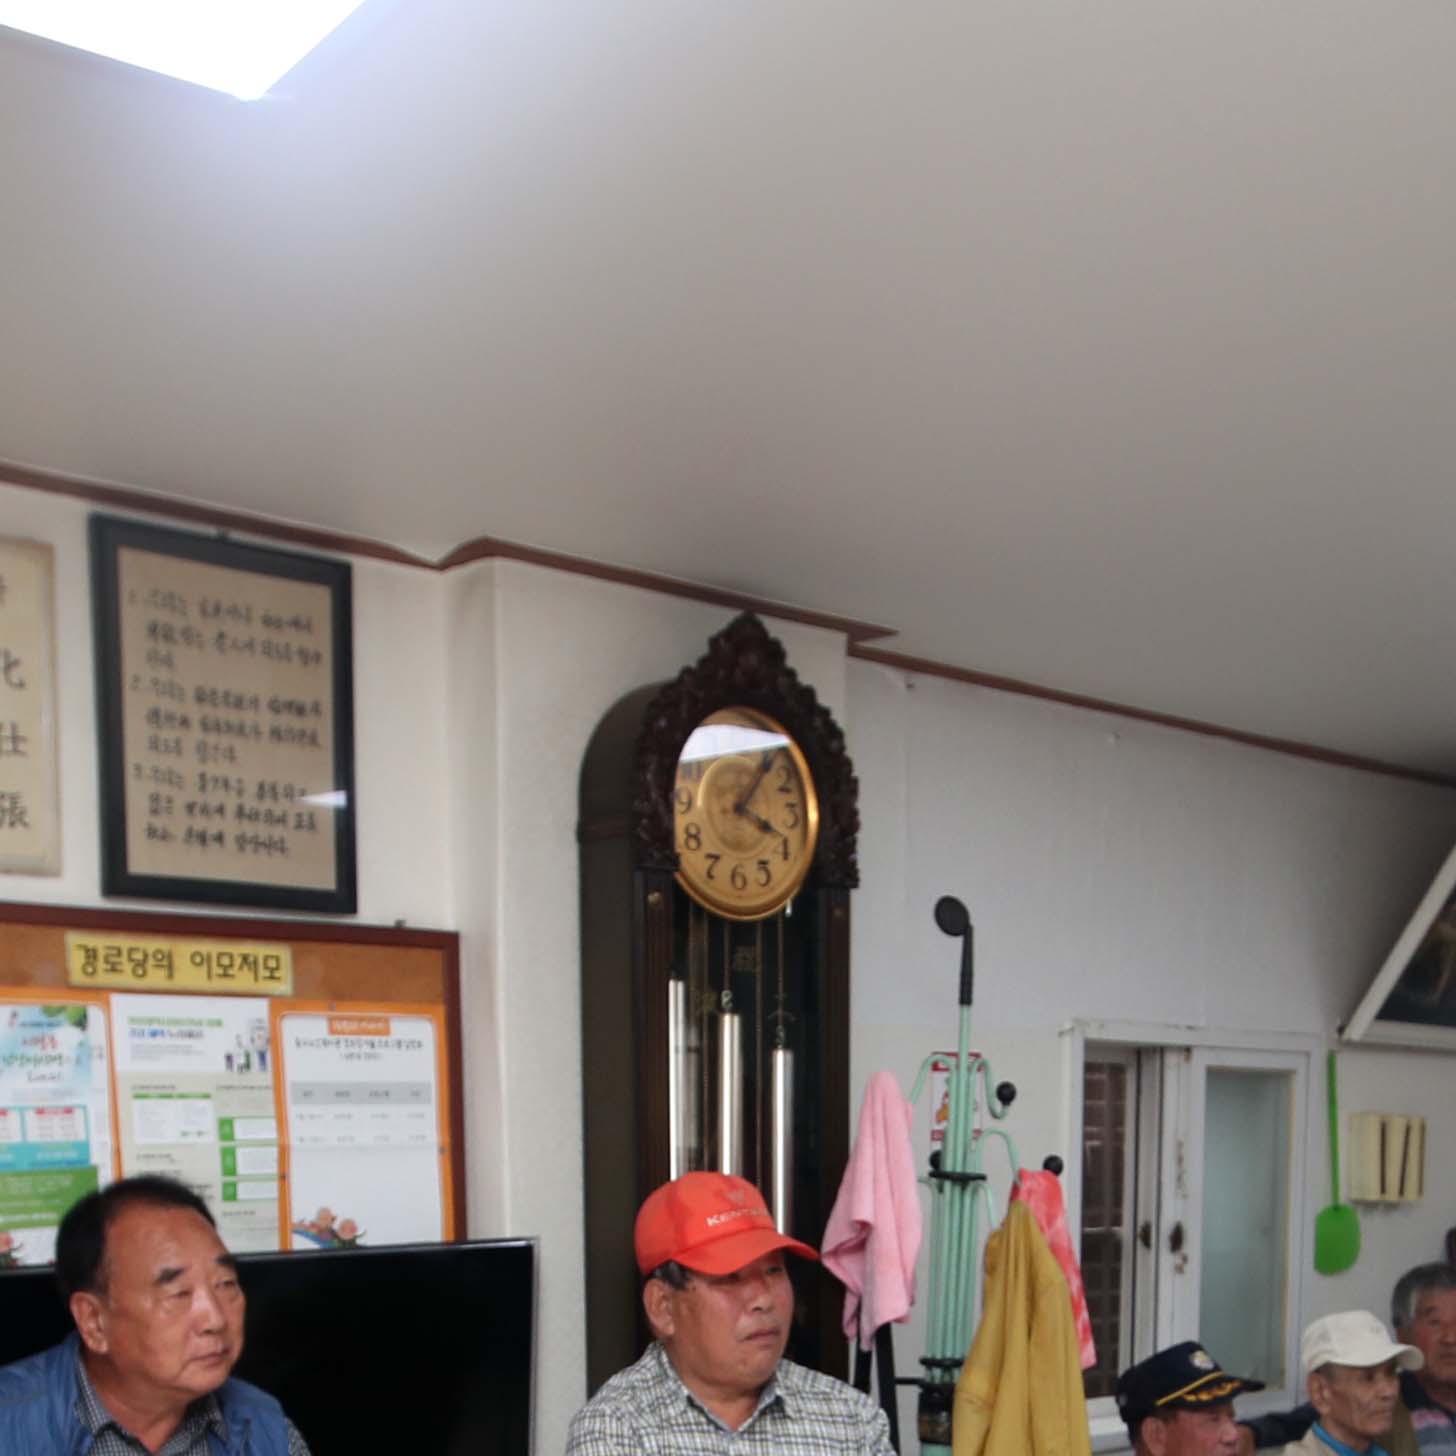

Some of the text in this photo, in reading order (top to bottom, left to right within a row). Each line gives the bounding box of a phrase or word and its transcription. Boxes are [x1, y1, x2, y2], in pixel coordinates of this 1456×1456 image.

[676, 787, 692, 814] 9
[783, 801, 800, 829] 3
[683, 821, 702, 851] 8
[704, 852, 721, 880] 7
[730, 863, 748, 891] 6
[755, 859, 772, 887] 5
[75, 942, 284, 983] 경로당의 이모저모
